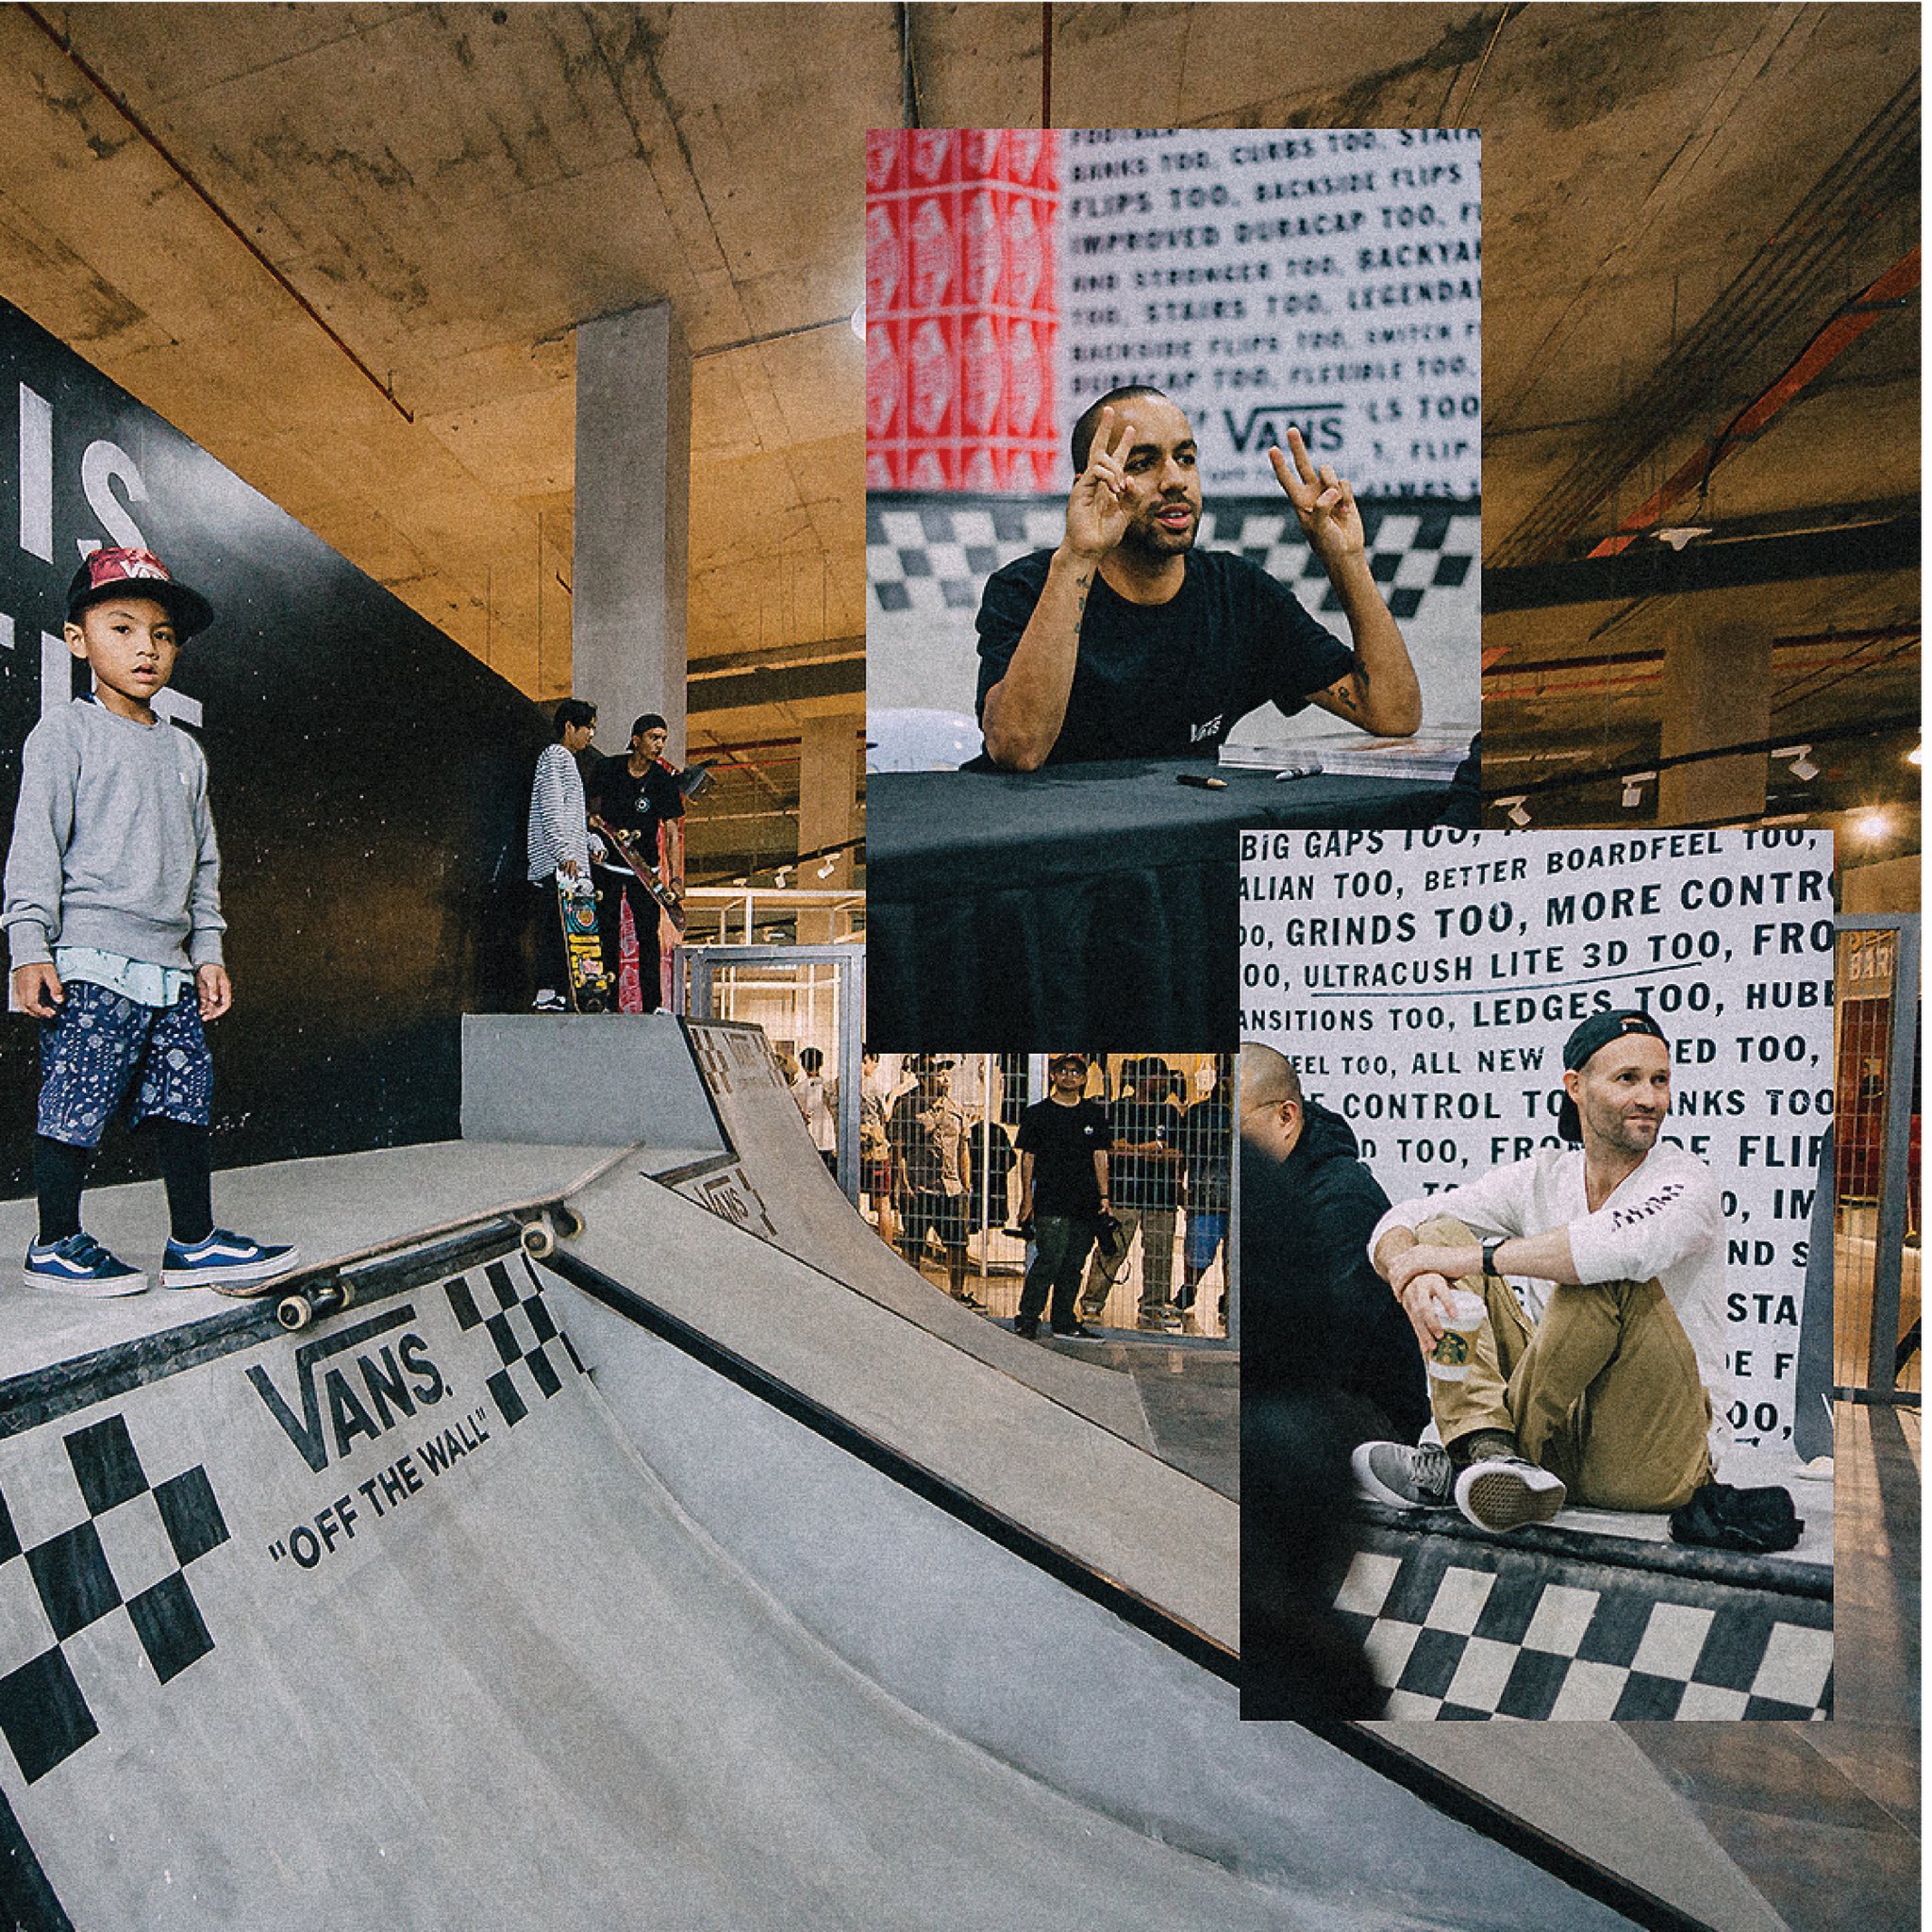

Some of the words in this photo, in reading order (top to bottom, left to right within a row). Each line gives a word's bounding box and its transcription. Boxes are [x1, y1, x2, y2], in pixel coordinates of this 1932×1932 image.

[1391, 163, 1461, 187] FLIPS
[1347, 277, 1481, 312] LEGENDA
[1223, 403, 1345, 454] VANS
[1305, 830, 1384, 859] GAPS
[1334, 869, 1404, 900] TOO,
[1425, 858, 1527, 891] BETTER
[1546, 831, 1724, 874] BOARDFEEL
[1286, 911, 1416, 946] GRINDS
[1434, 901, 1527, 939] TOO,
[1546, 883, 1661, 927] MORE
[1680, 870, 1834, 911] CONTR
[1304, 956, 1473, 989] ULTRACUSH
[1491, 945, 1564, 978] LITE
[1582, 940, 1628, 969] 3D
[1647, 930, 1733, 963] TOO,
[1389, 1006, 1456, 1032] TOO,
[1473, 989, 1612, 1028] LEDGES
[1634, 981, 1724, 1017] TOO,
[1341, 1056, 1396, 1078] TOO,
[1411, 1051, 1461, 1074] ALL
[1477, 1046, 1544, 1073] NEW
[1736, 1035, 1820, 1067] TOO,
[1342, 1091, 1501, 1120] CONTROL
[1397, 1138, 1469, 1169] TOO,
[358, 1456, 425, 1518] THE
